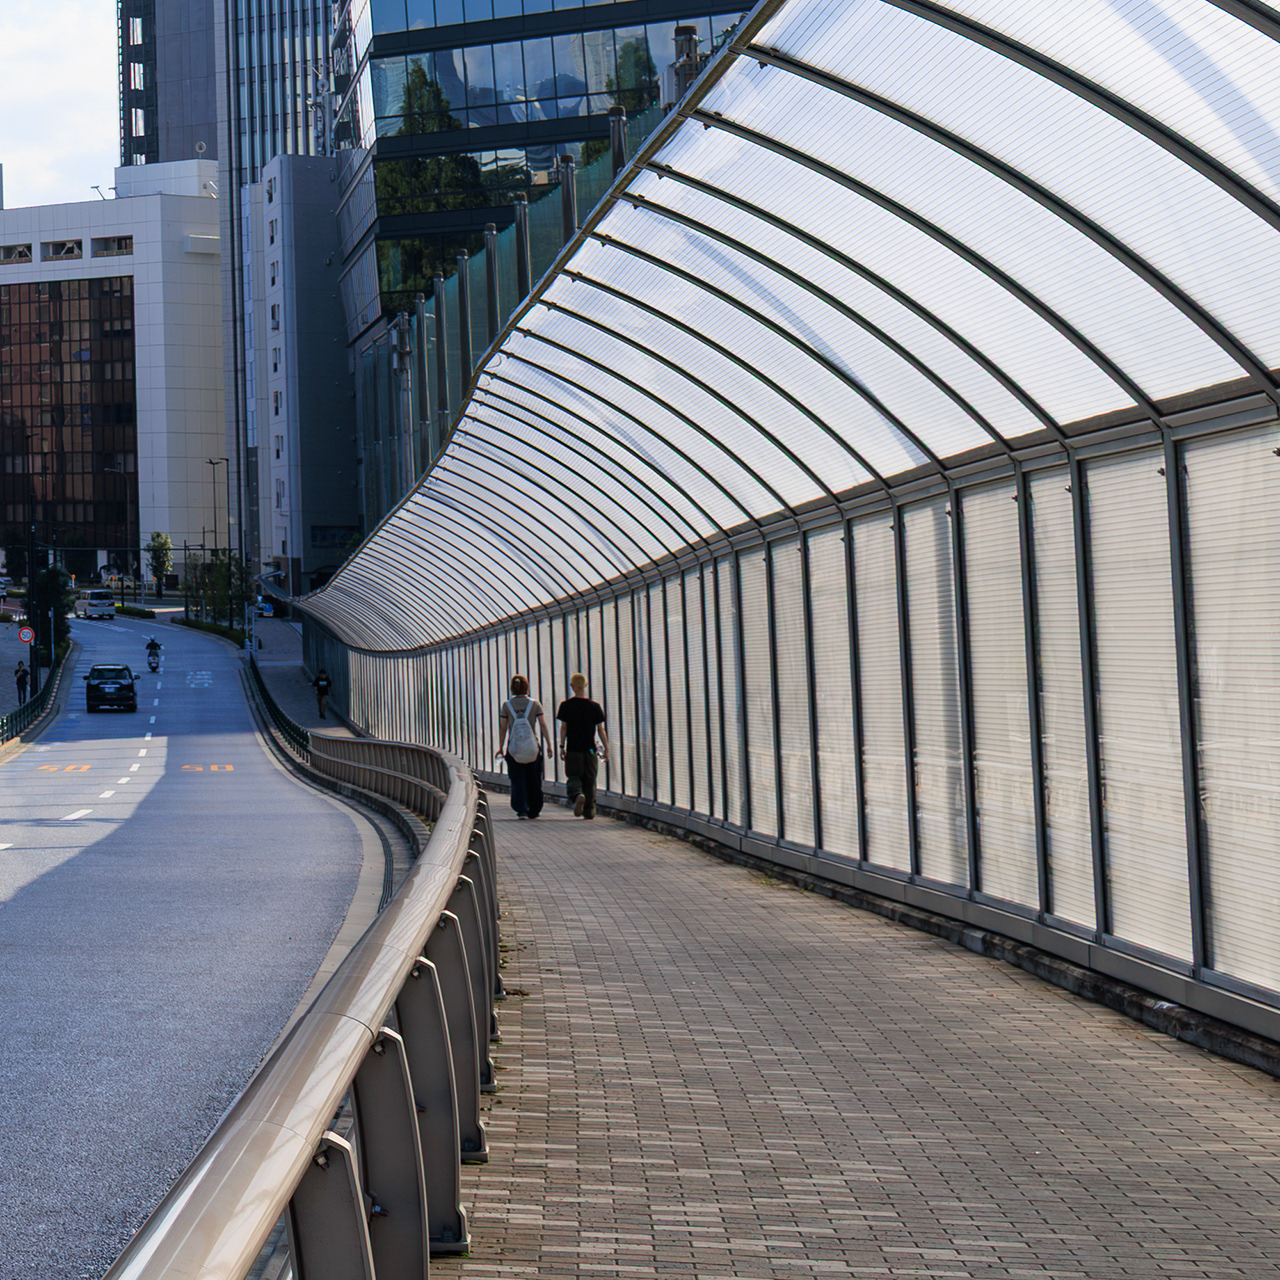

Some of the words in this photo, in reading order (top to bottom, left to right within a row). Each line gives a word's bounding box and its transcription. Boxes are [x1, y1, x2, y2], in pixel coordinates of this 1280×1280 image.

[21, 631, 31, 639] 50
[36, 764, 92, 772] 50
[180, 764, 234, 772] 50
